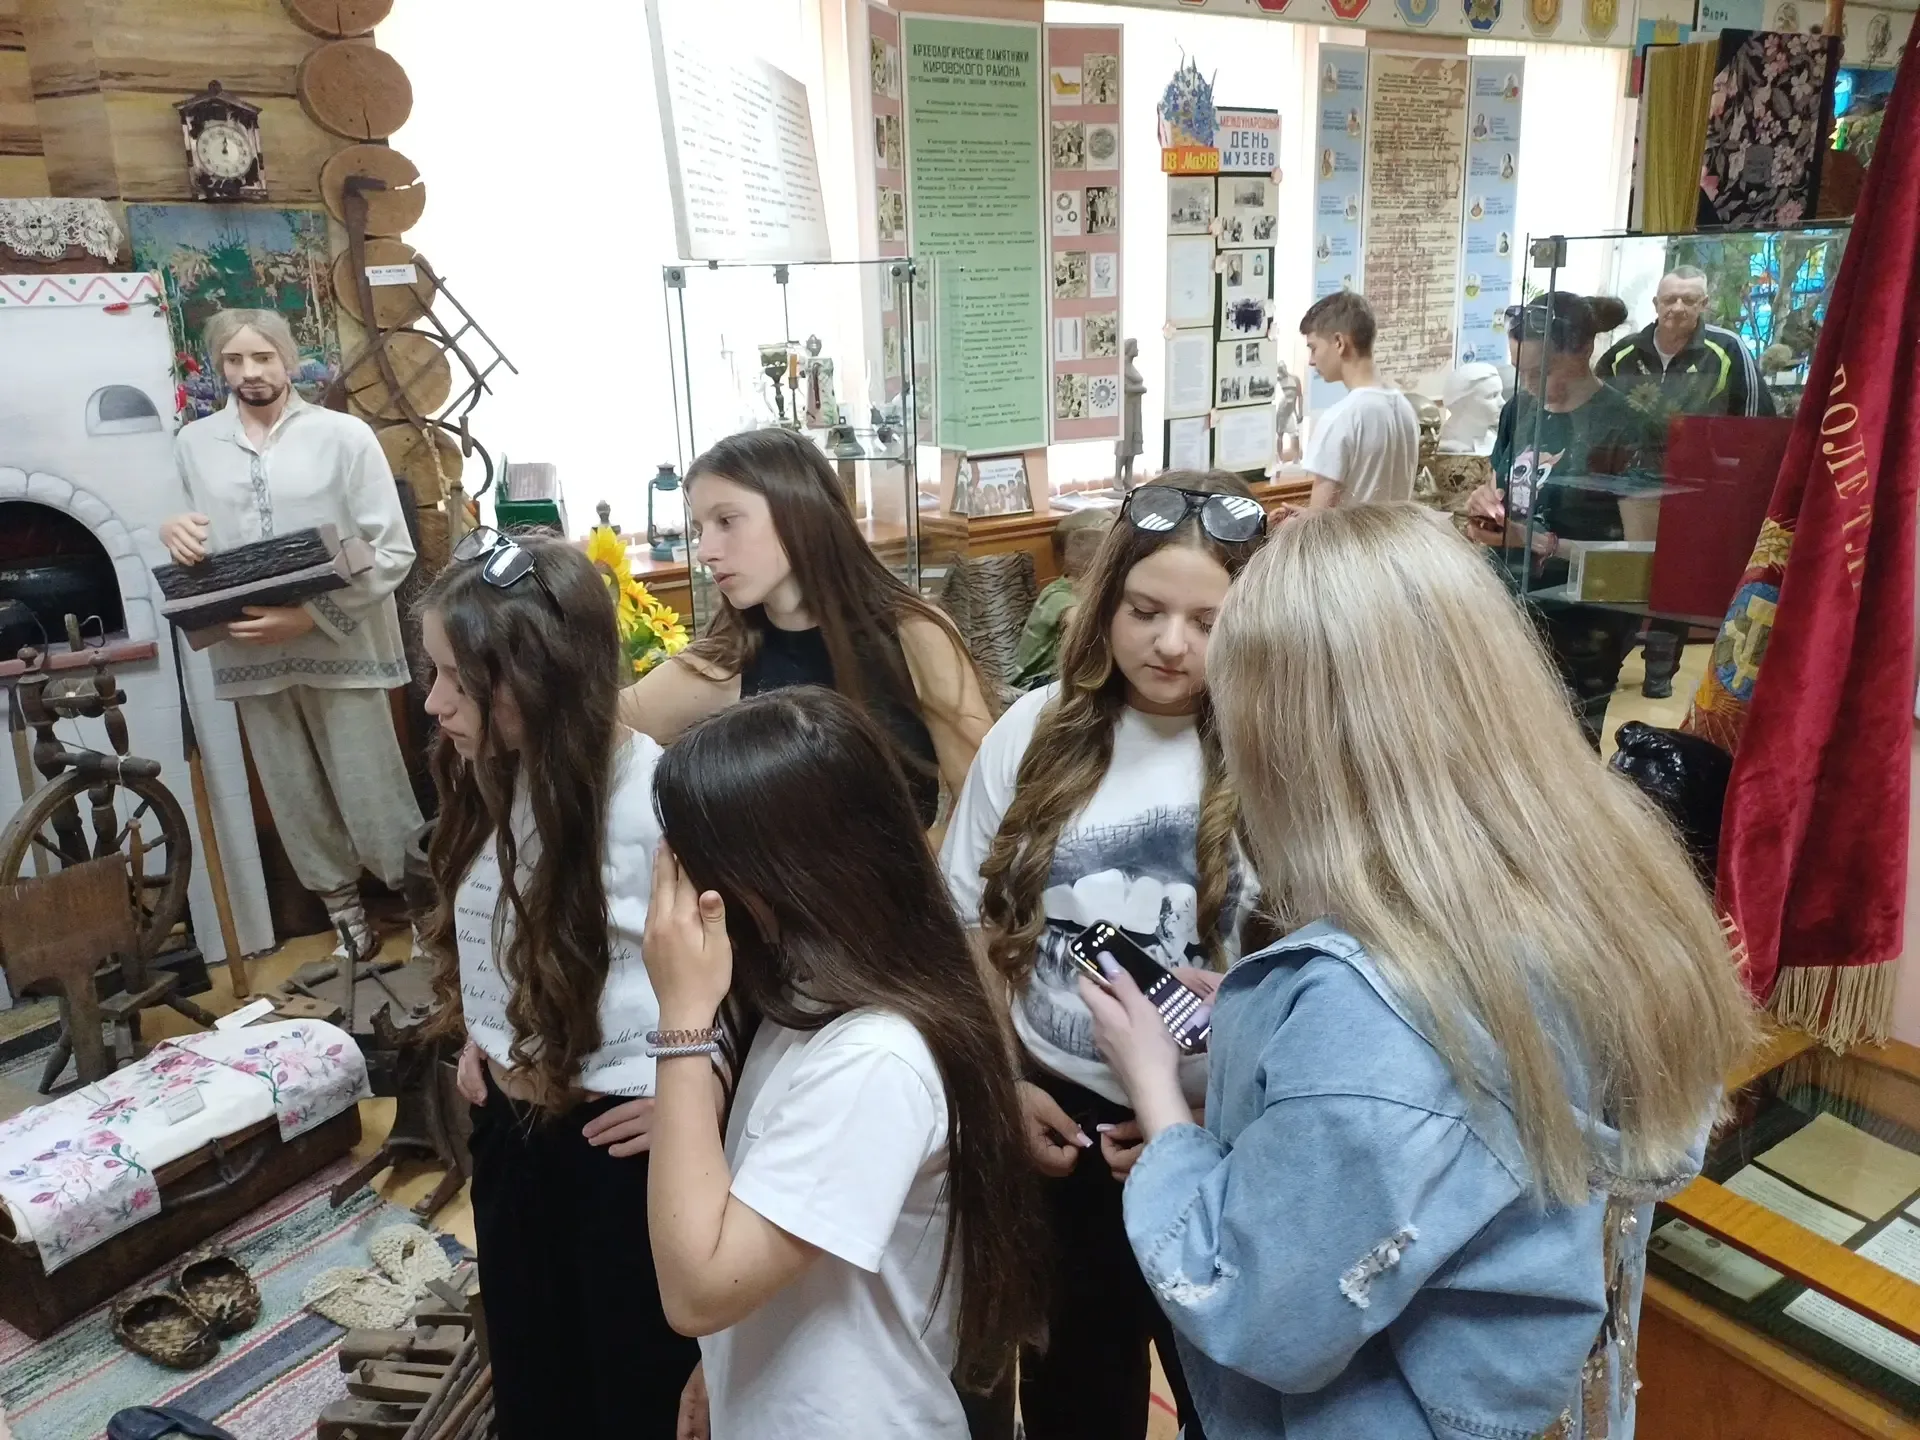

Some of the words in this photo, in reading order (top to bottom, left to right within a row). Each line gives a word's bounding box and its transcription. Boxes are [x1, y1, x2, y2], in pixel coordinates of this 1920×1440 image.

[913, 44, 985, 61] АРХЕОЛОГИЧЕСКИЕ
[986, 48, 1030, 63] ПАМЯТНИКИ
[922, 60, 984, 76] КИРОВСКОГО
[985, 63, 1021, 78] РАЙОНА
[1230, 131, 1270, 149] ДЕНЬ
[1223, 151, 1275, 166] МУЗЕЕВ
[602, 1027, 643, 1047] oulders
[605, 1081, 648, 1096] orning
